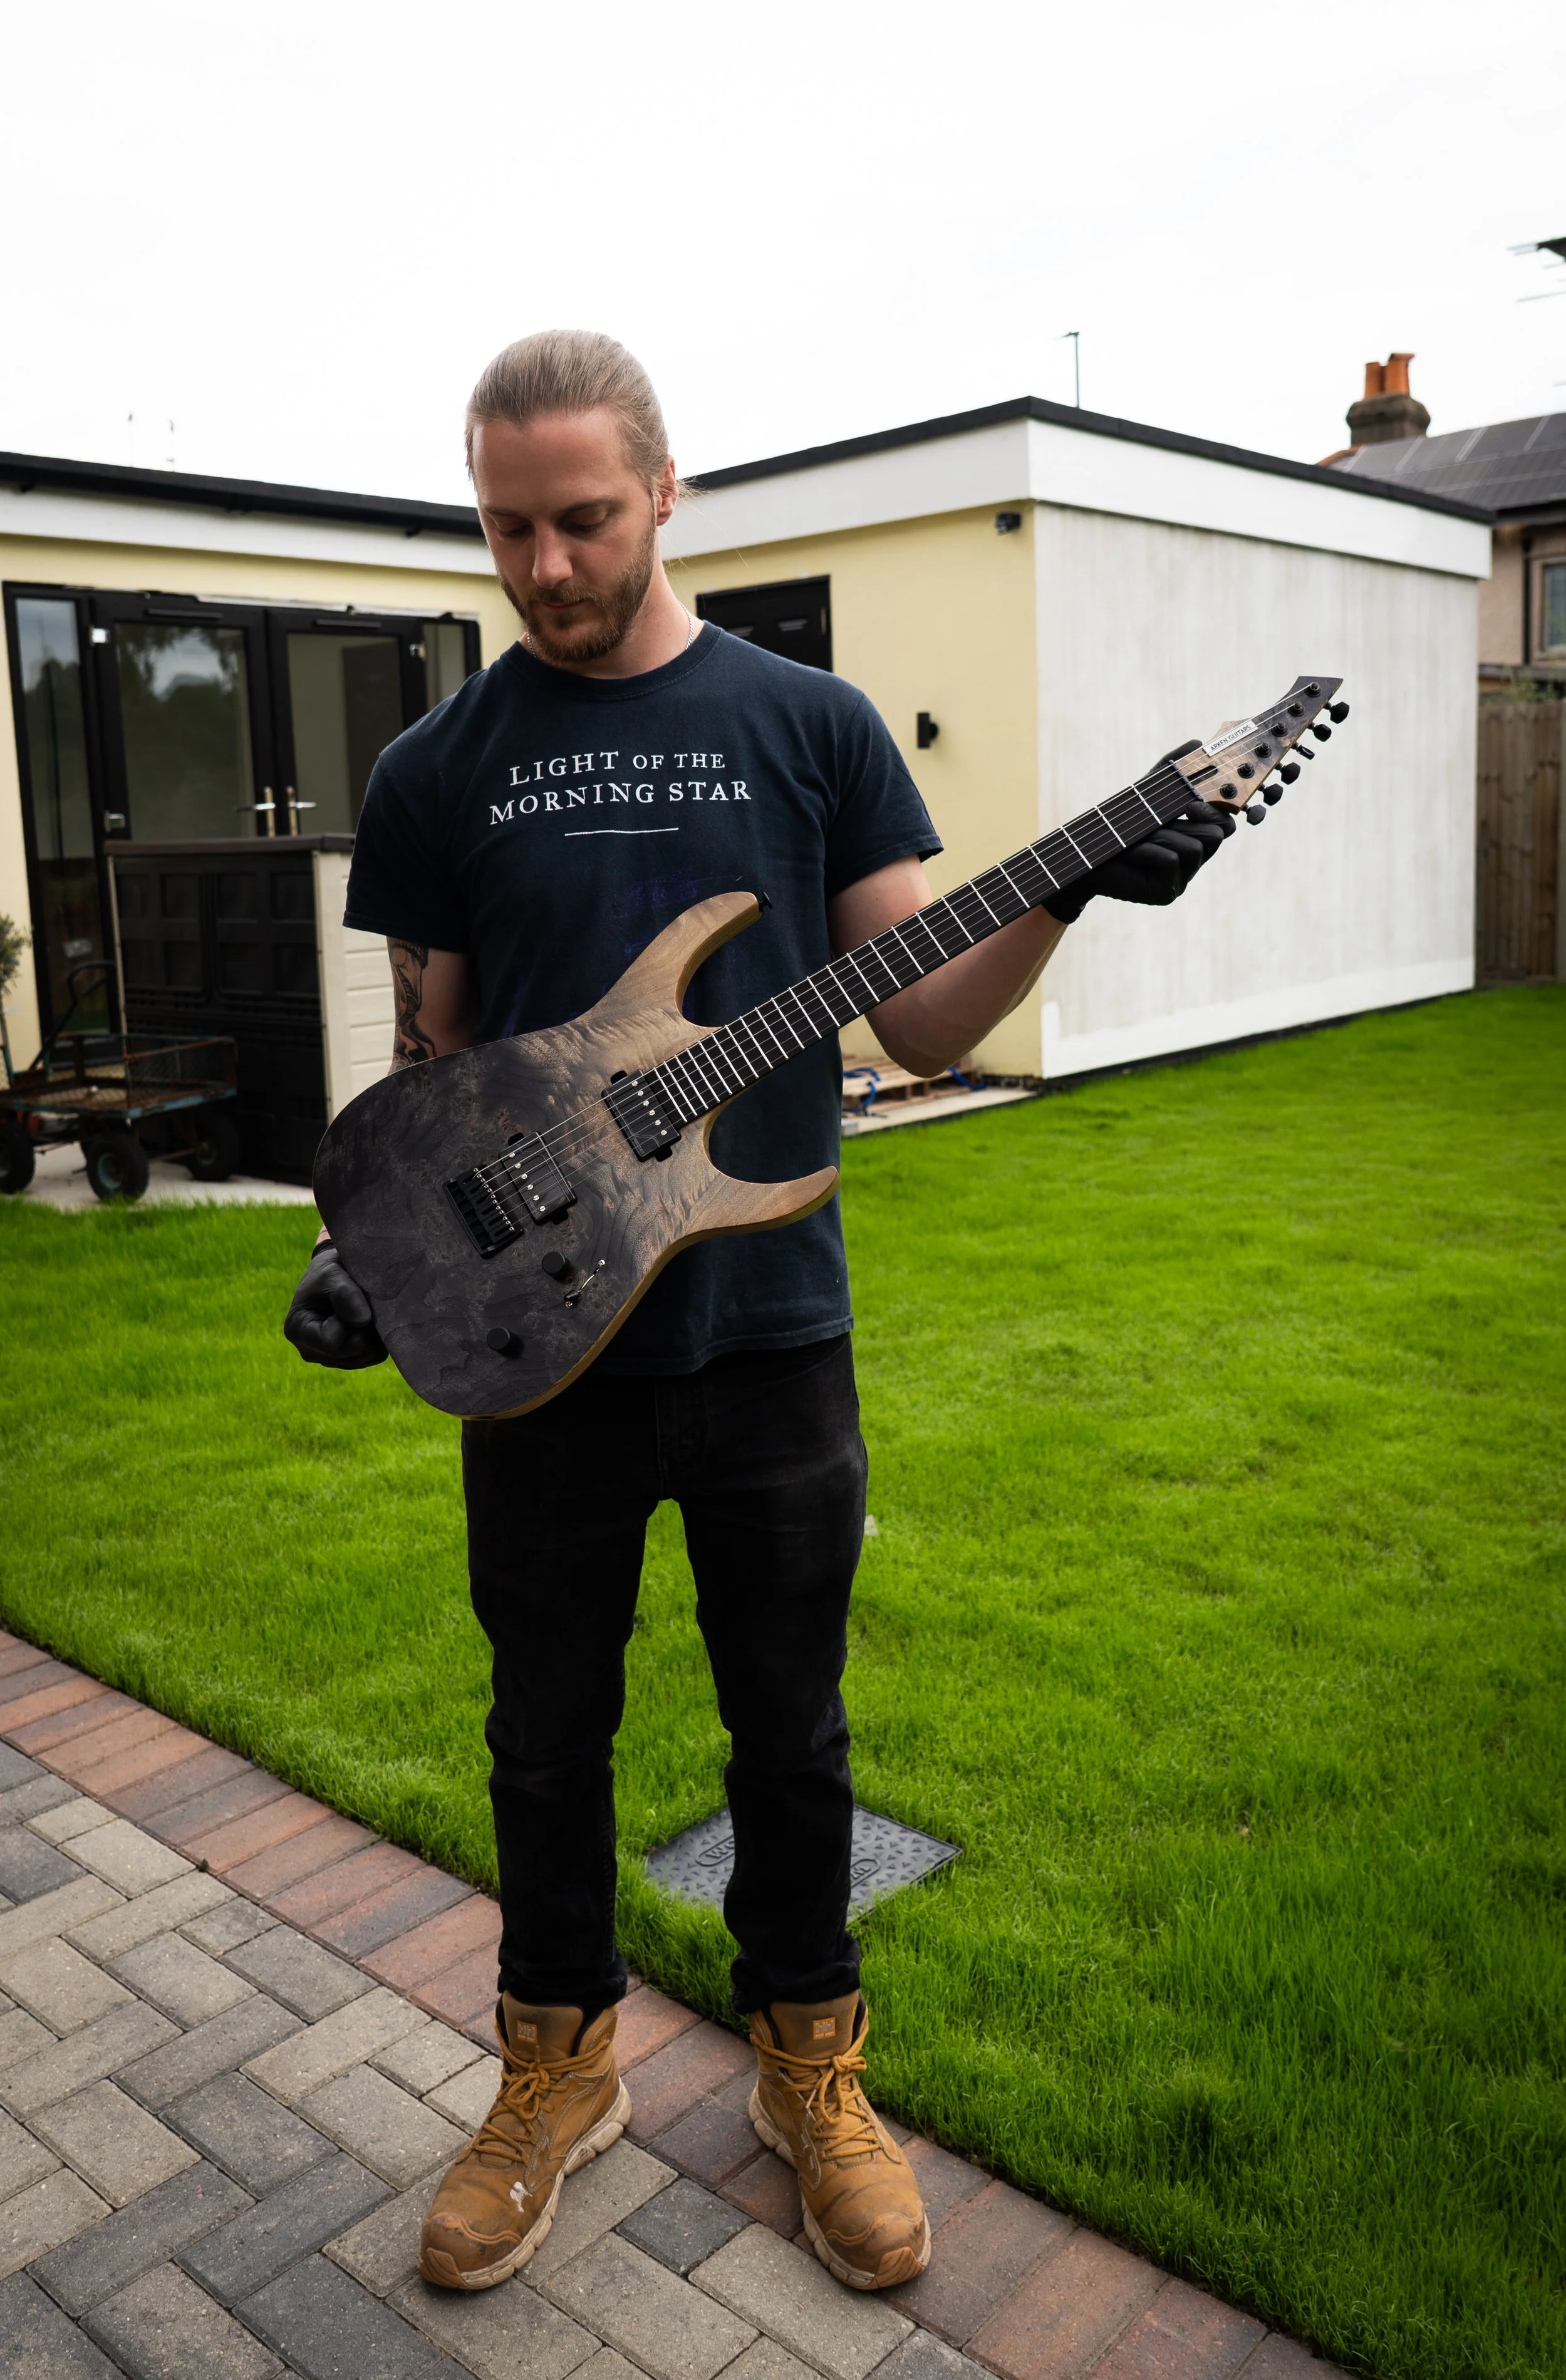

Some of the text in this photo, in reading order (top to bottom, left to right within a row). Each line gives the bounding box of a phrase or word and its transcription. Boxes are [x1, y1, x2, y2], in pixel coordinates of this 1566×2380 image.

[1210, 724, 1252, 751] ARKEN GUITARS
[509, 750, 725, 786] LIGHT OF THE
[489, 780, 752, 825] MORNING STAR
